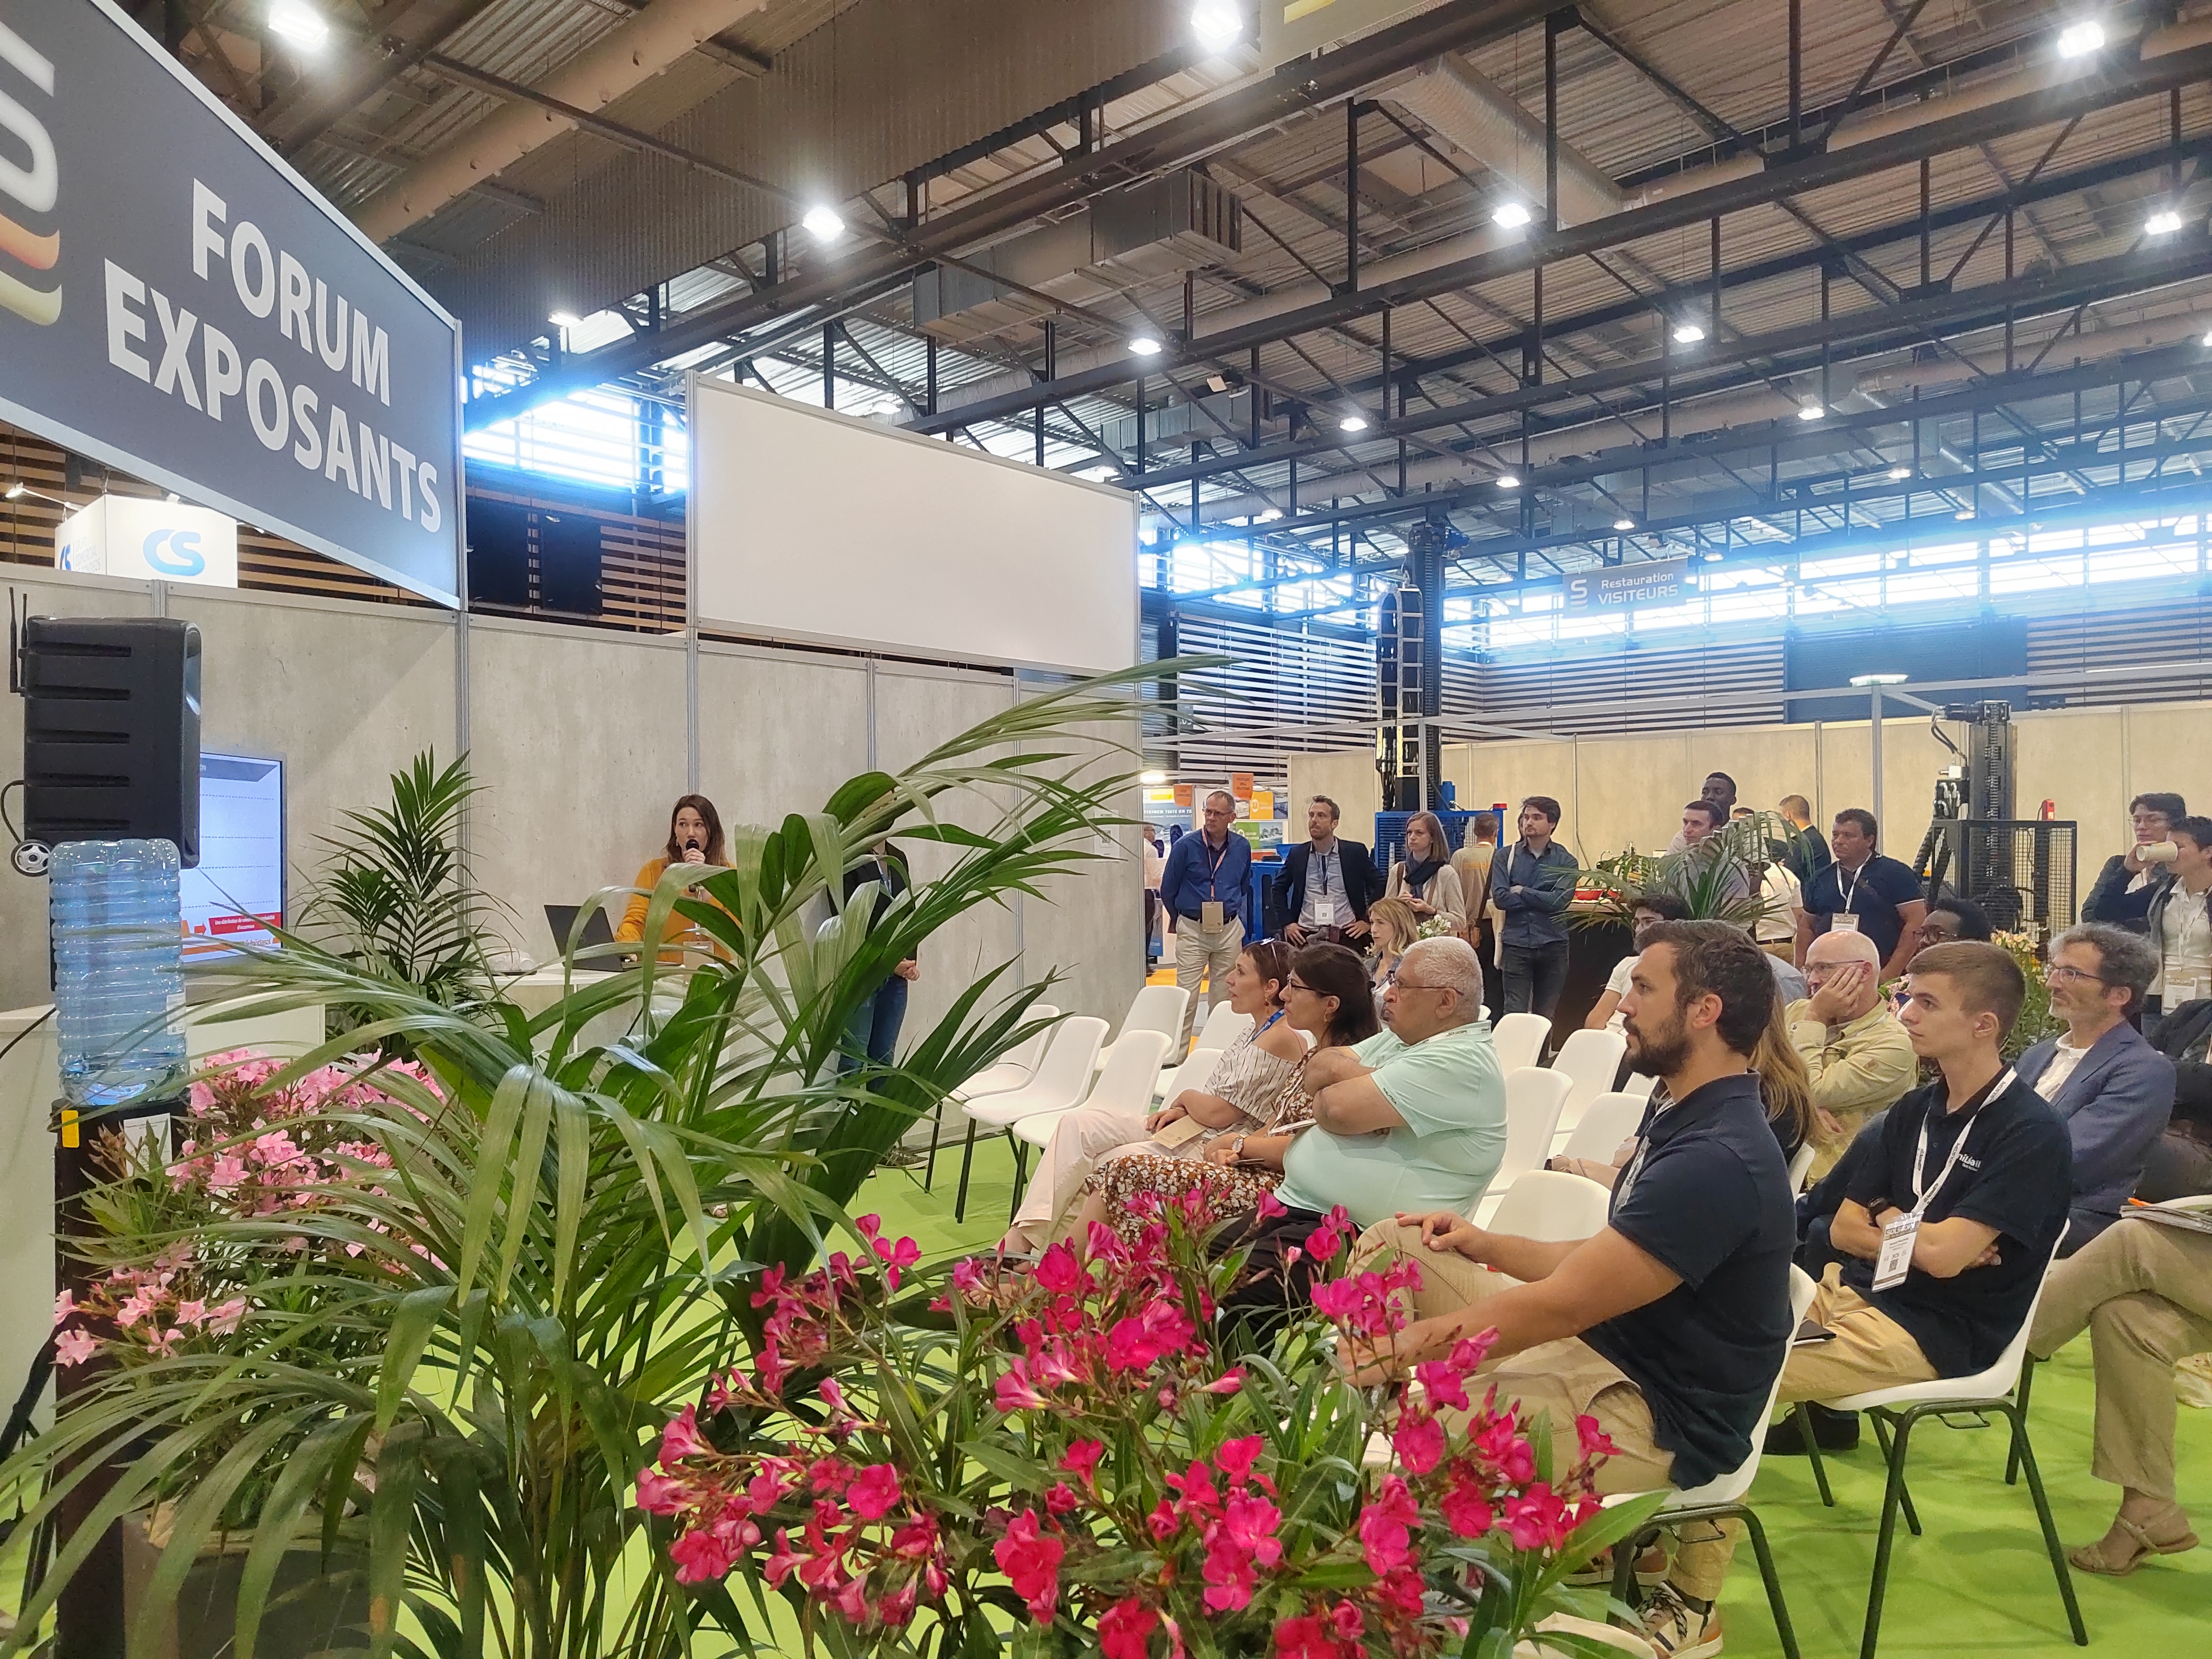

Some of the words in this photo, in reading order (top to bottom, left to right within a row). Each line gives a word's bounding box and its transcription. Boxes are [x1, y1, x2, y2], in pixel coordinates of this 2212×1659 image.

[193, 178, 390, 407] FORUM
[105, 258, 441, 533] EXPOSANTS
[143, 529, 205, 576] CS
[1598, 584, 1678, 605] VISITEURS
[1601, 572, 1674, 589] Restauration
